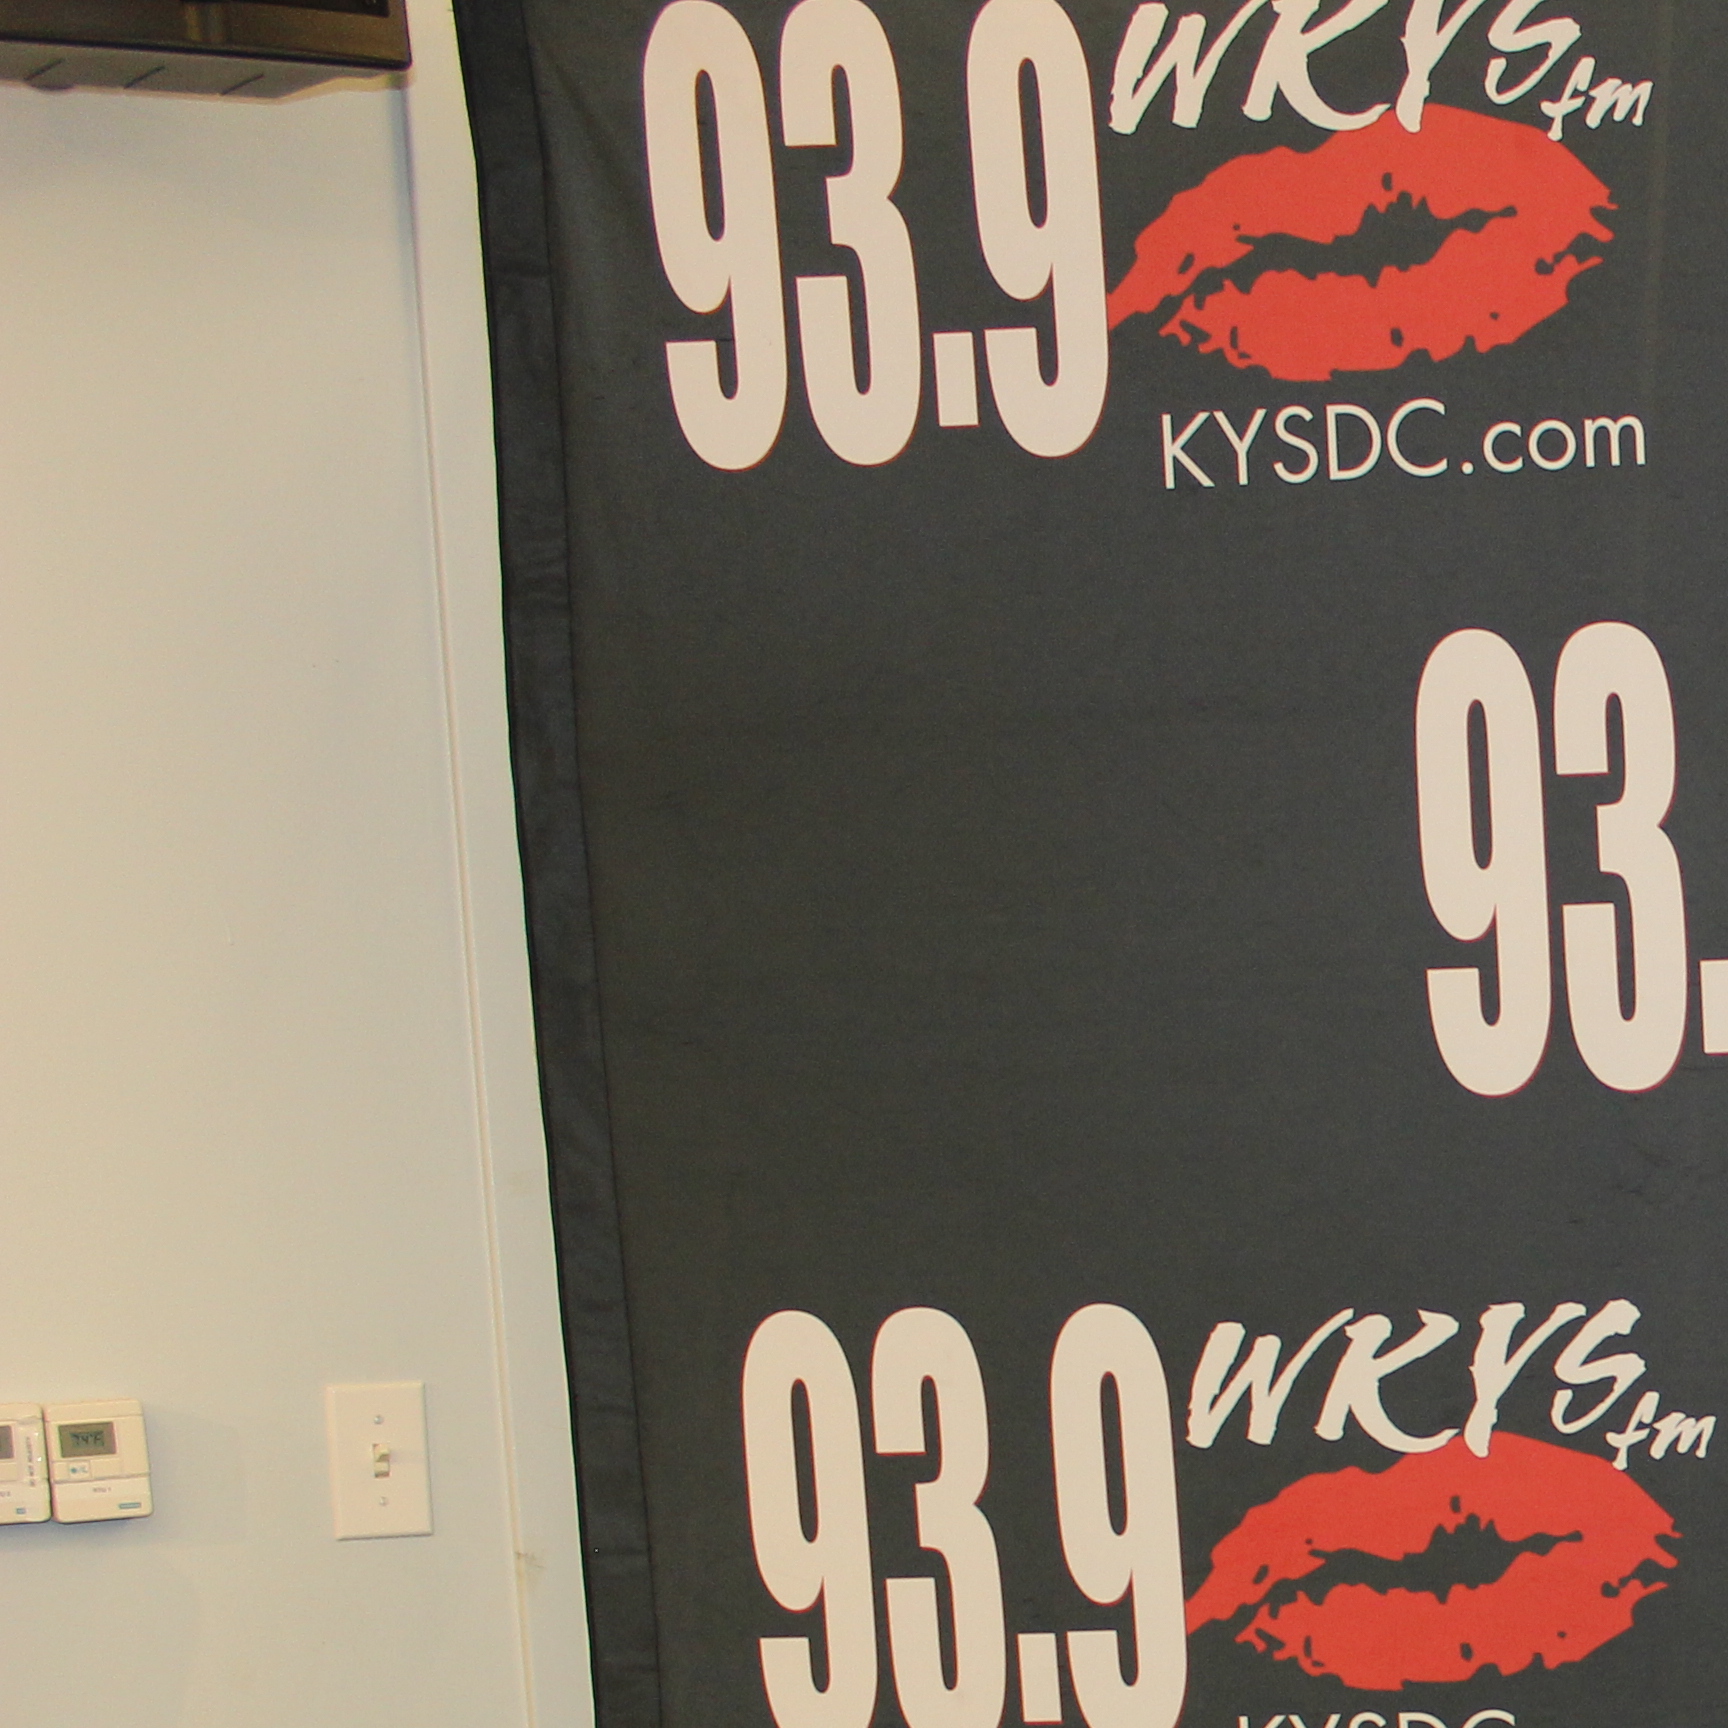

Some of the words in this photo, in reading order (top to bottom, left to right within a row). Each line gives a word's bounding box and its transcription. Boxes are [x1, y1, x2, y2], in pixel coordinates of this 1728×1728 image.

[1108, 0, 1582, 135] WKYS
[642, 0, 1109, 471] 93.9
[1160, 398, 1648, 490] KYSDC.com
[1185, 1298, 1647, 1458] WKYS
